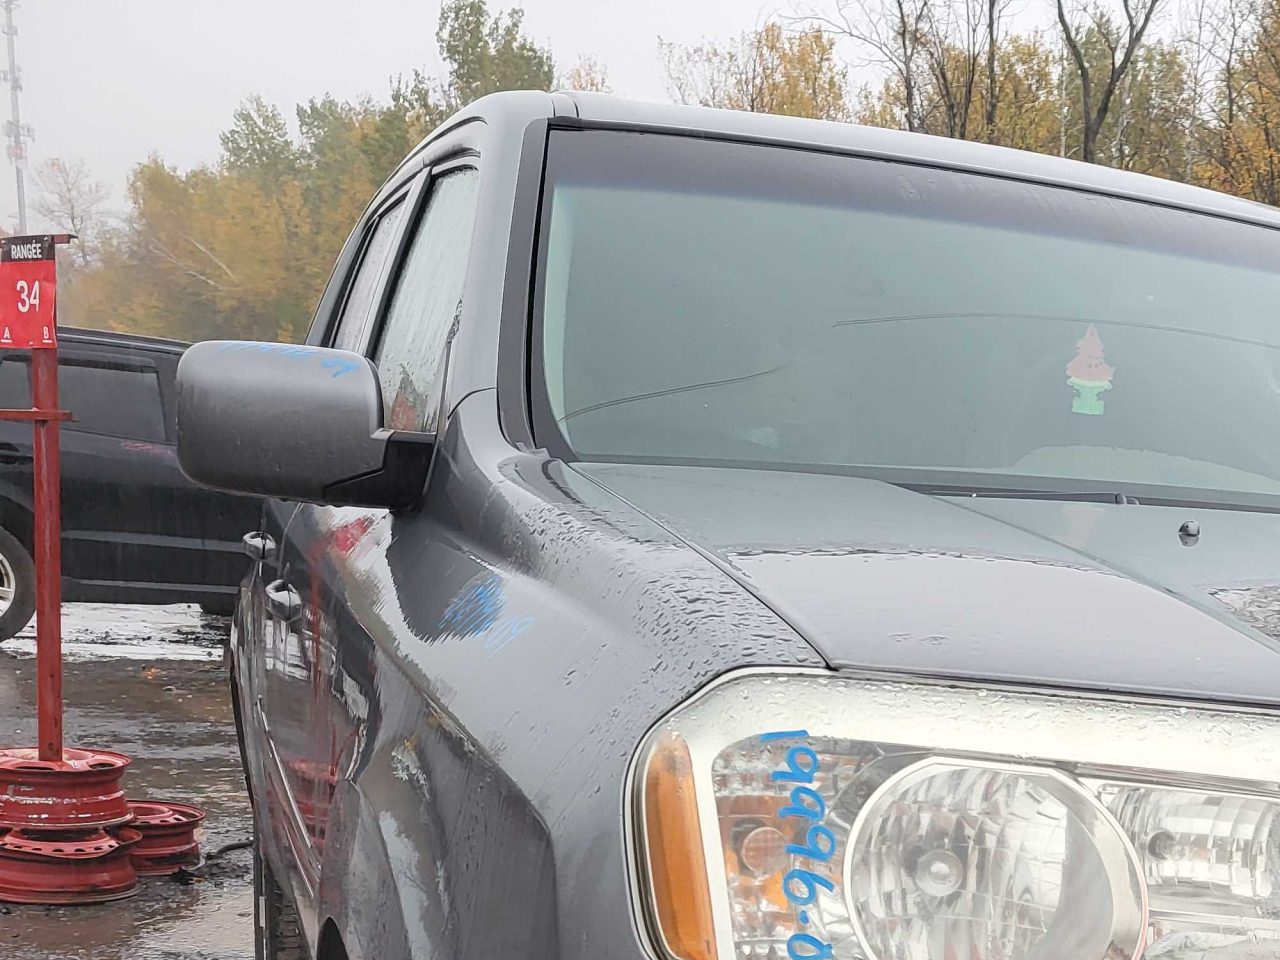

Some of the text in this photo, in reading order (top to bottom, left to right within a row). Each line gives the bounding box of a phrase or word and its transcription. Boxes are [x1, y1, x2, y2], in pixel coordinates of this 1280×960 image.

[11, 240, 42, 259] RANGÉE
[16, 280, 40, 313] 34
[3, 326, 49, 339] A B
